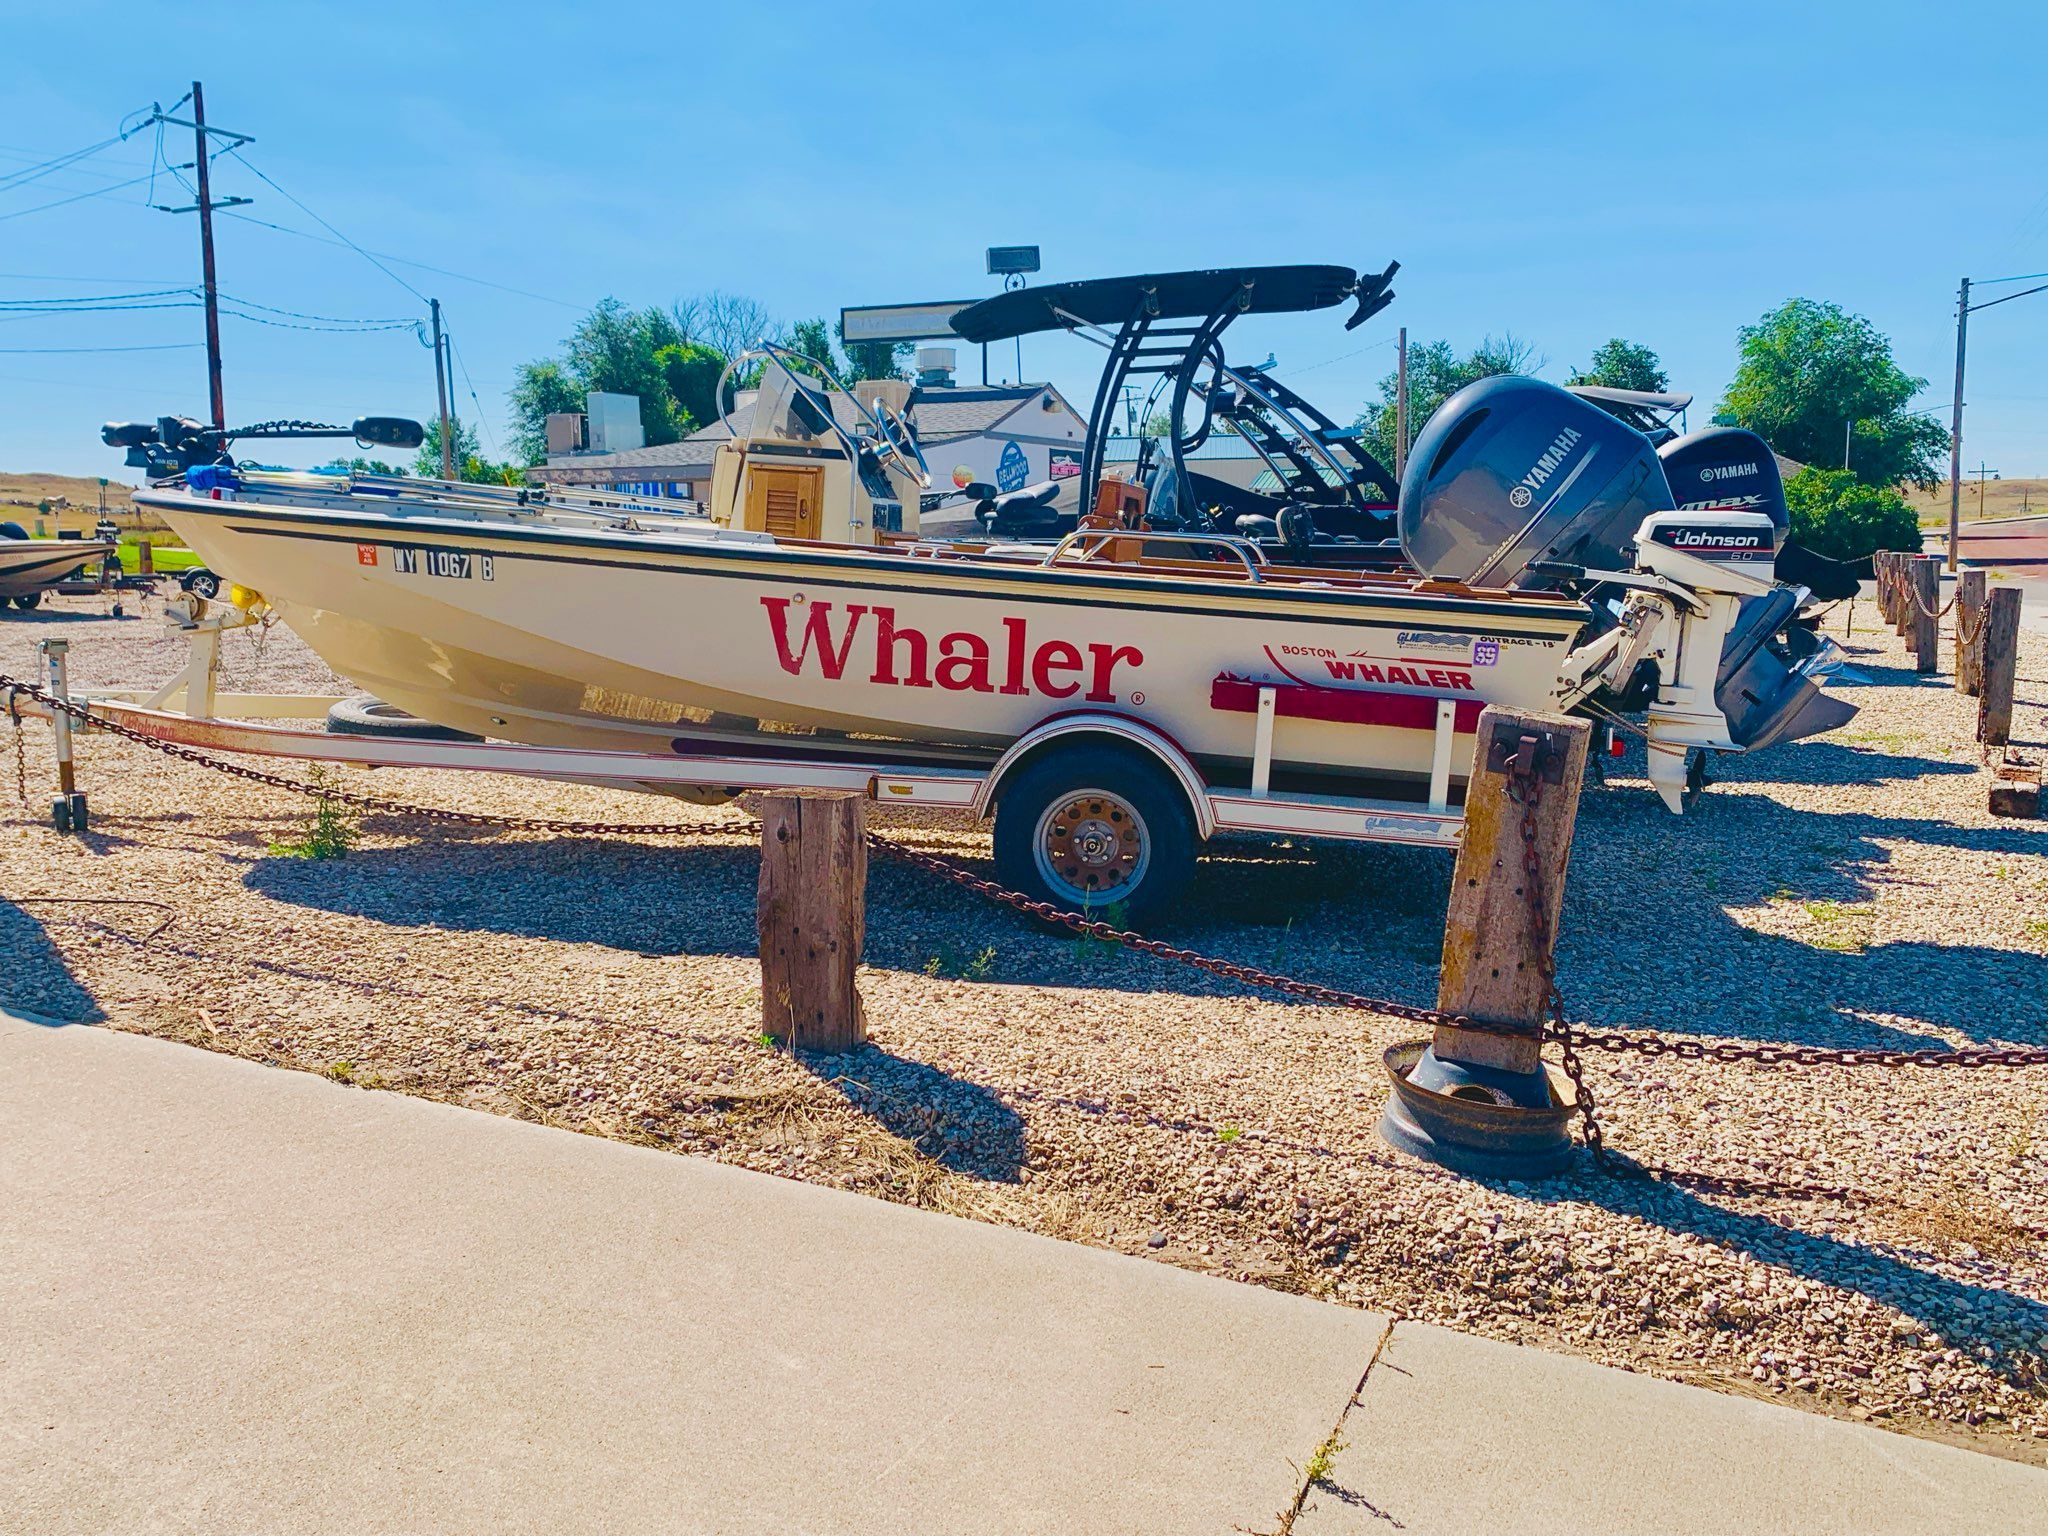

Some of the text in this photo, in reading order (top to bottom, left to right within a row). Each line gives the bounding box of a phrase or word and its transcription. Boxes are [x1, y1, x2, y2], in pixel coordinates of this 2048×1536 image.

[1521, 426, 1582, 490] YAMAHA
[1714, 462, 1759, 480] YAMAHA
[1674, 530, 1759, 546] Johnson
[394, 549, 494, 581] WY 1067 B
[1731, 552, 1753, 561] 60
[1397, 632, 1421, 645] GLM
[1480, 636, 1533, 647] OUTRAGE
[759, 596, 1144, 704] Whaler
[1281, 645, 1337, 659] BOSTON
[1324, 660, 1475, 690] WHALER
